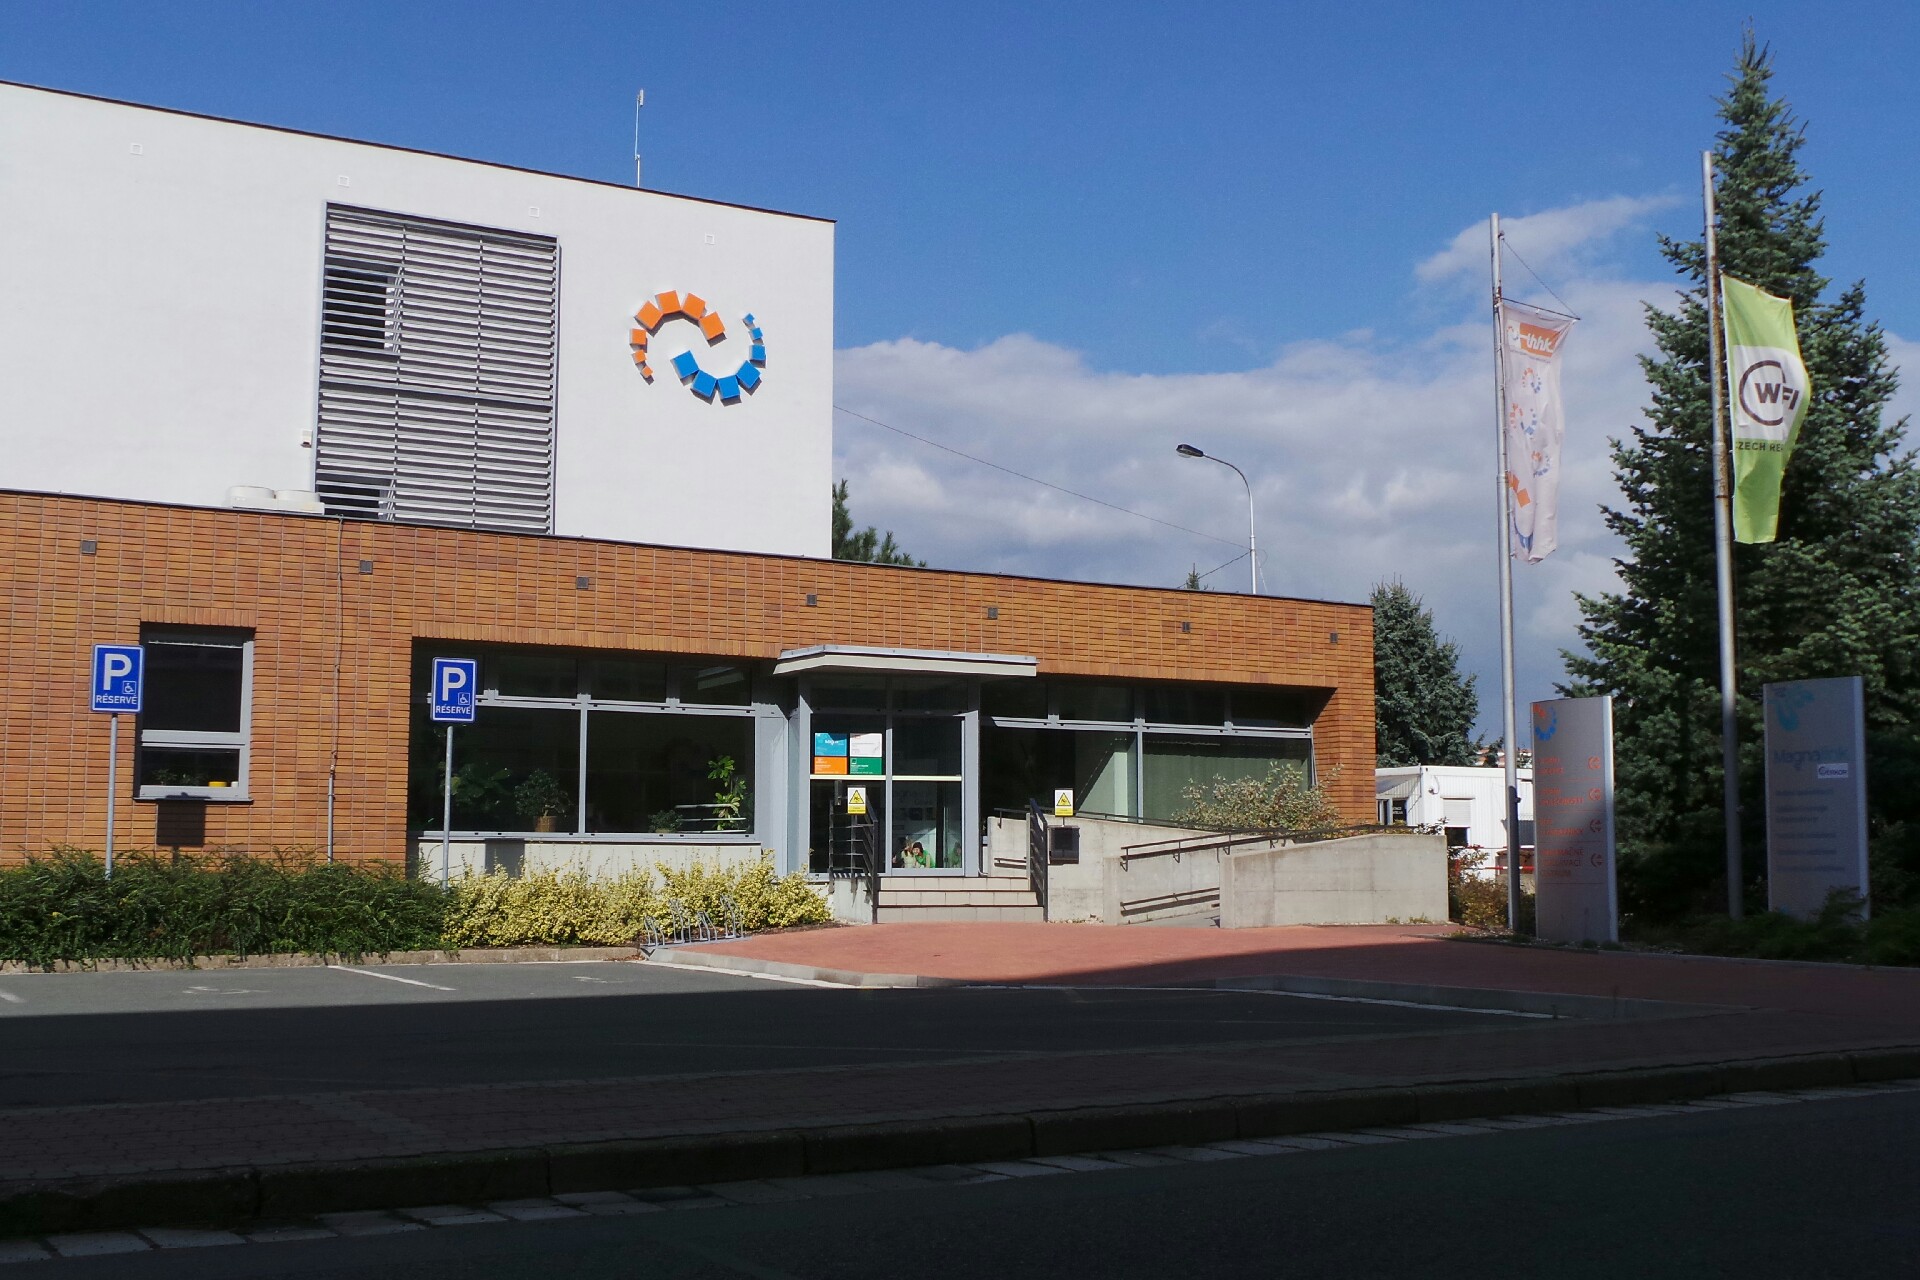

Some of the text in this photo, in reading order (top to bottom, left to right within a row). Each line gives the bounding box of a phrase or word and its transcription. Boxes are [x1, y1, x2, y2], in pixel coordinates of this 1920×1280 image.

[1736, 441, 1766, 451] ZECH
[104, 653, 132, 691] P
[442, 666, 467, 702] P
